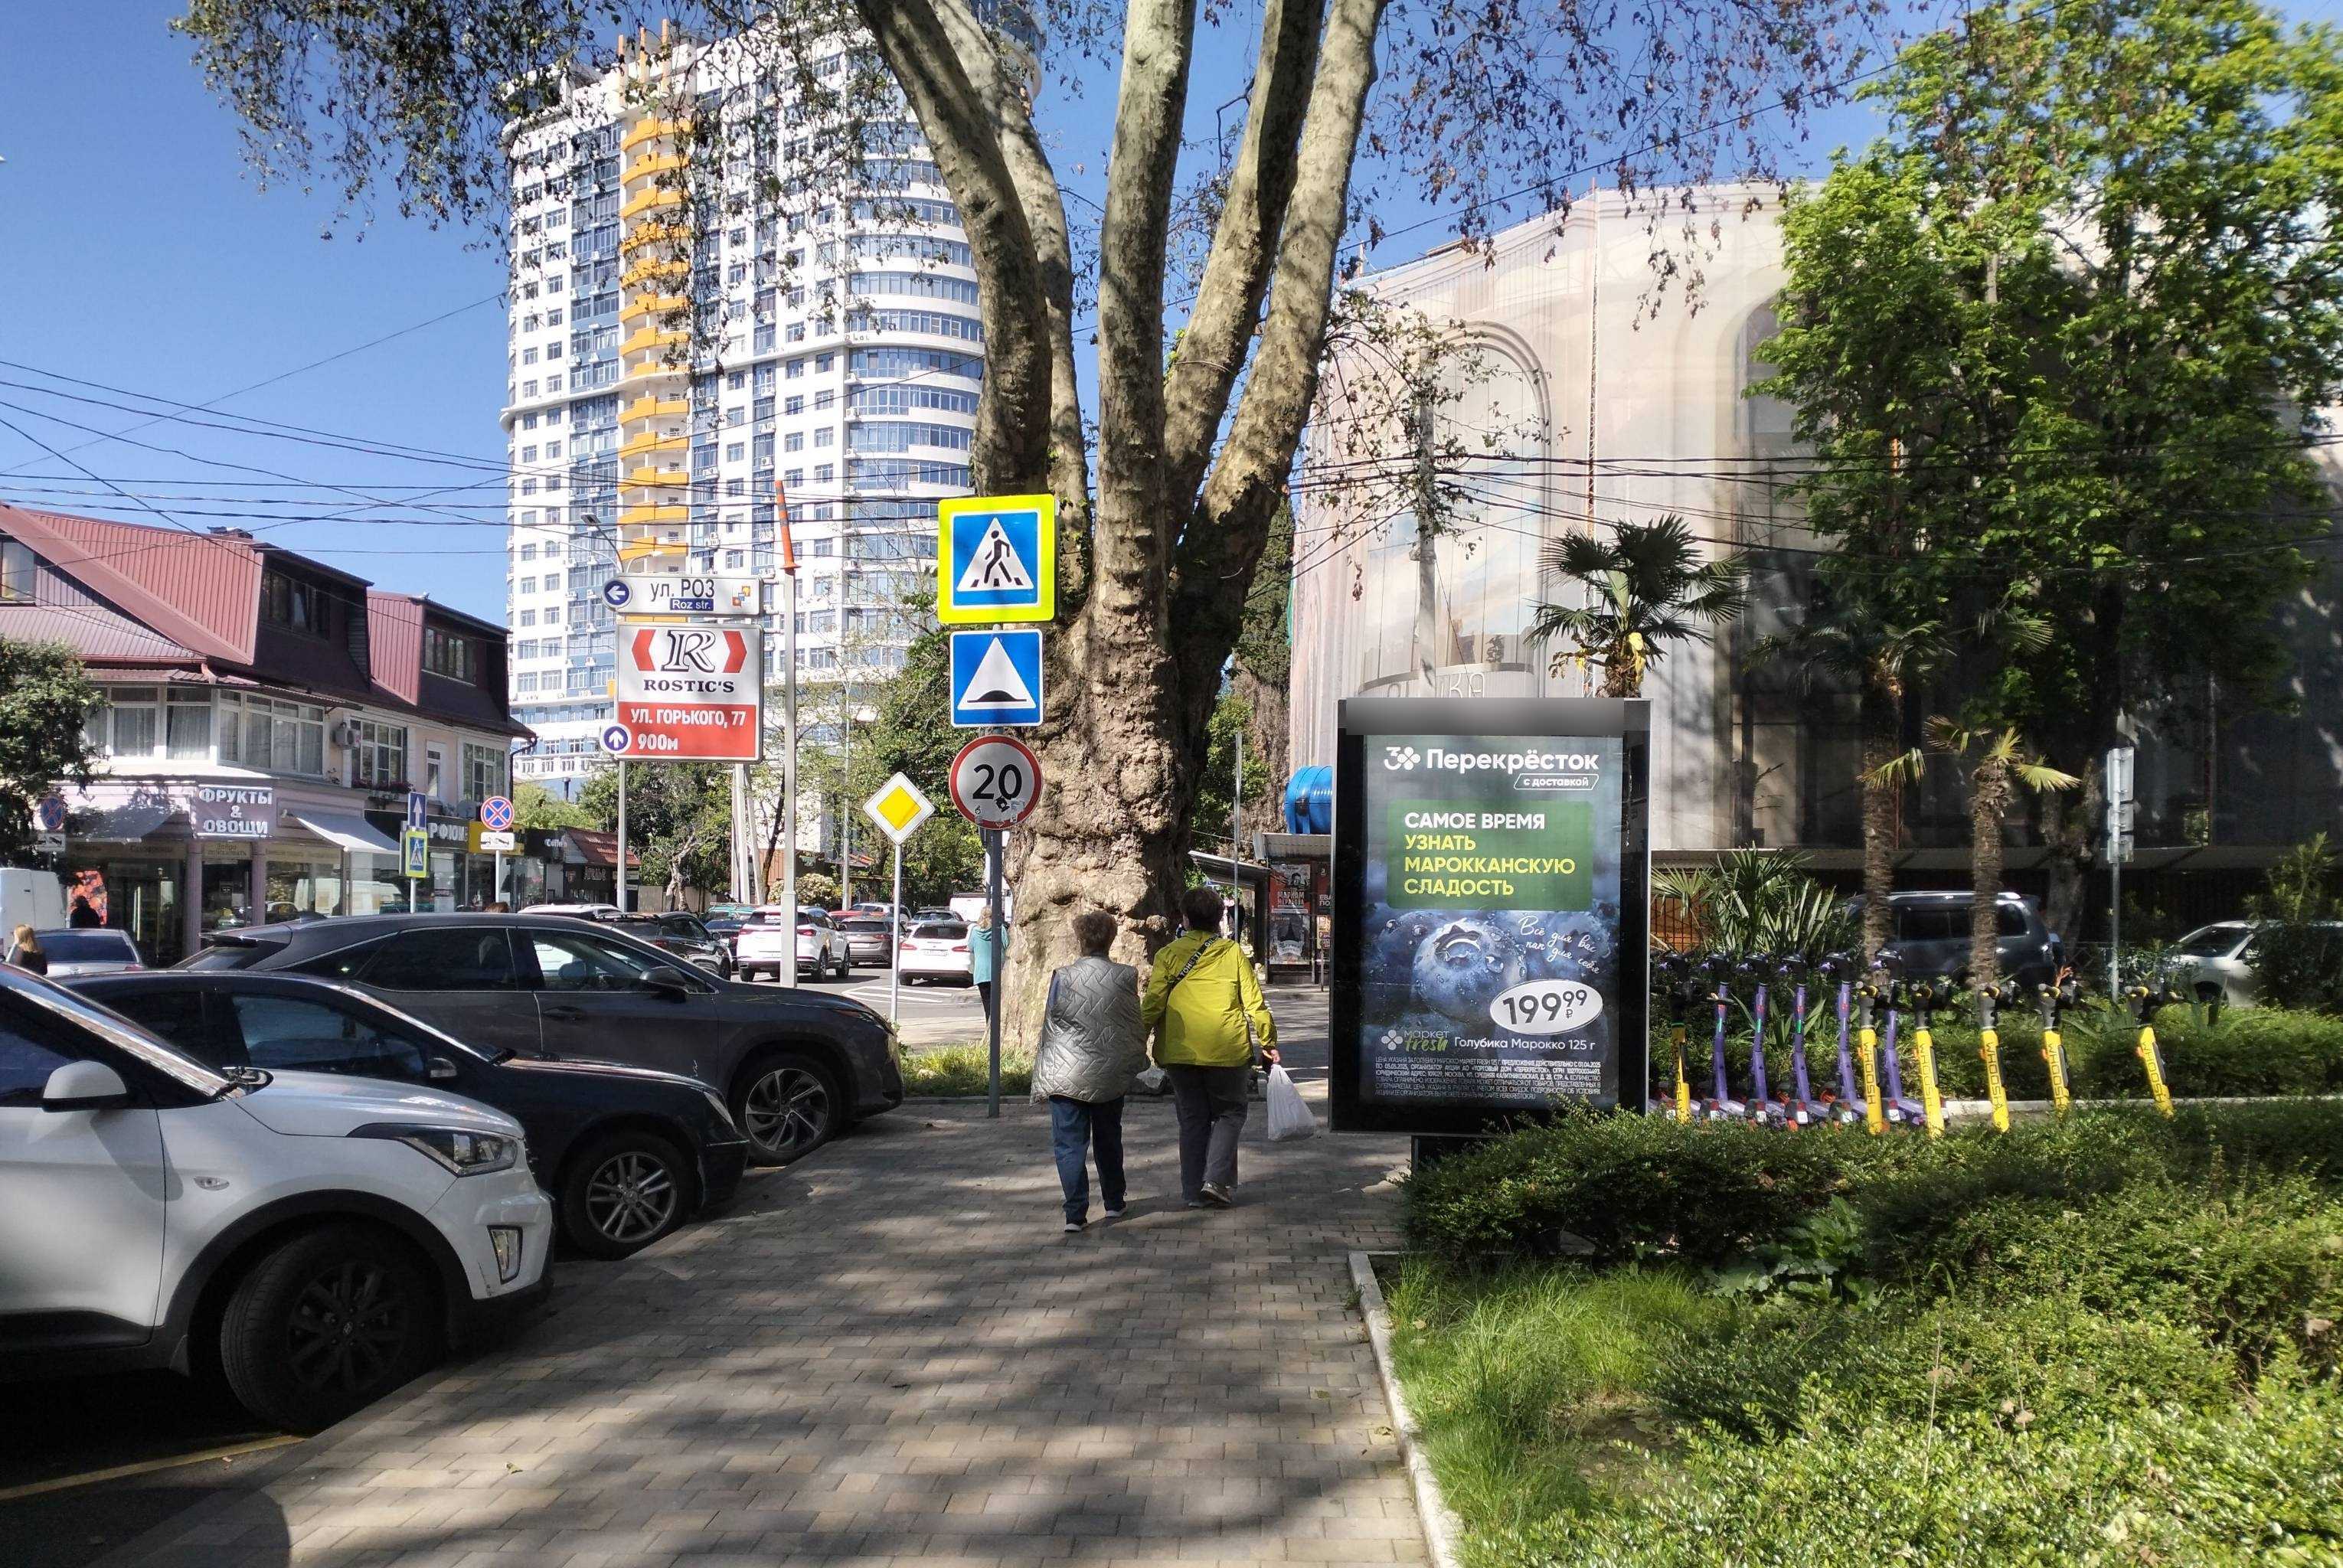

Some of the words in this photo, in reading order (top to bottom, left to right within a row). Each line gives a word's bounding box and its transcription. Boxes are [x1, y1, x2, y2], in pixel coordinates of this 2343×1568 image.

[650, 583, 675, 602] ул.
[681, 579, 715, 598] РОЗ
[672, 600, 693, 609] Roz
[696, 600, 711, 609] str.
[643, 679, 735, 693] ROSTIC'S
[630, 708, 653, 724] УЛ.
[656, 709, 727, 729] ГОРЬКОГО,
[731, 710, 747, 726] 77
[638, 733, 678, 750] 900м
[1426, 749, 1600, 774] Перекрёсток
[972, 764, 1022, 800] 20
[1532, 776, 1589, 787] доставкой
[198, 788, 273, 805] ФРУКТЫ
[230, 805, 242, 818] &
[203, 819, 268, 835] ОВОЩИ
[1404, 812, 1476, 829] САМОЕ
[1482, 813, 1545, 829] ВРЕМЯ
[1405, 835, 1476, 851] УЗНАТЬ
[1404, 857, 1576, 874] МАРОККАНСКУЮ
[1404, 878, 1515, 897] СЛАДОСТЬ
[1404, 1029, 1450, 1040] маркет
[1454, 1036, 1508, 1050] Голубика
[1511, 1037, 1566, 1050] Марокко
[1568, 1040, 1588, 1050] 125
[1404, 1036, 1449, 1052] fresh
[1863, 1042, 1876, 1105] WHOOSH
[1986, 1042, 2004, 1108] WHOOSH
[2047, 1044, 2066, 1107] WHOOSH
[2142, 1041, 2165, 1102] WHOOSH
